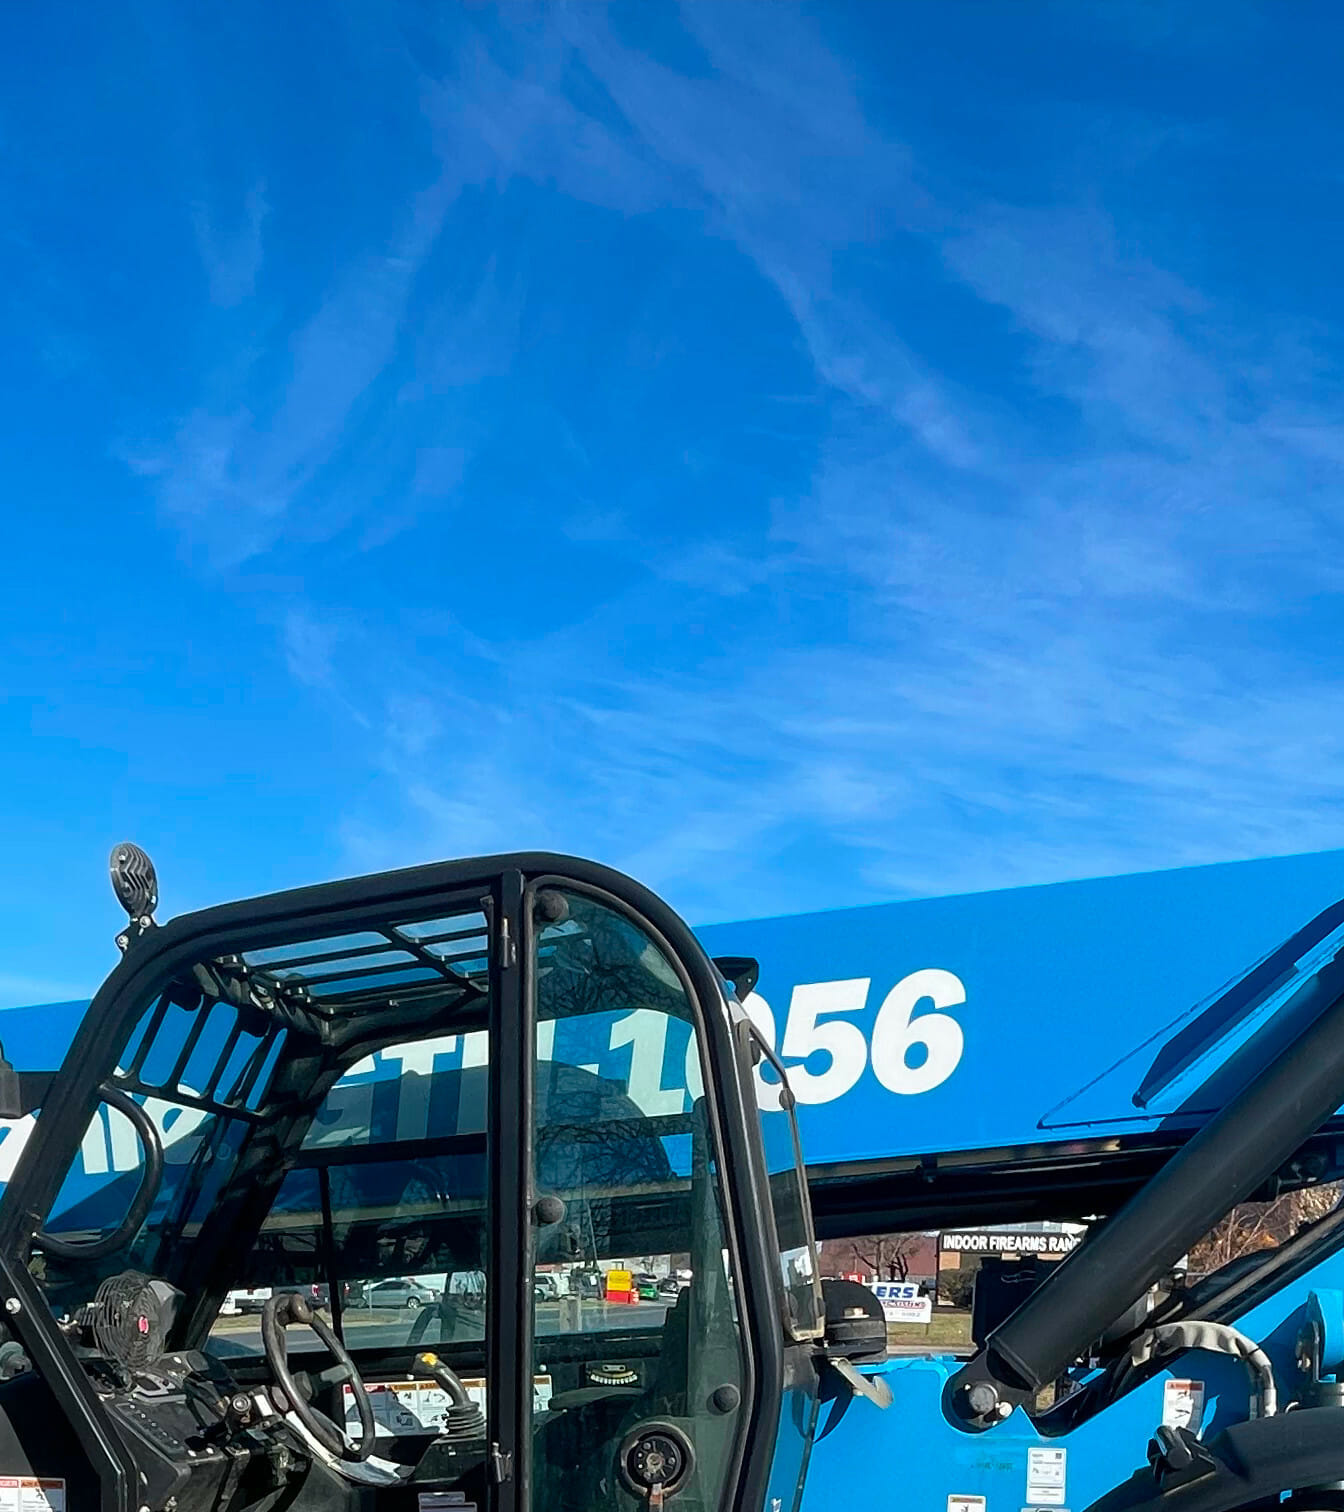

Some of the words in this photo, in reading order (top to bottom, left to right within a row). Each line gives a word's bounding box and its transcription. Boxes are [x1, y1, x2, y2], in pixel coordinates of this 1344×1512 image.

[943, 1235, 988, 1249] INDOOR
[989, 1236, 1047, 1251] FIREARMS
[876, 1286, 915, 1298] ERS
